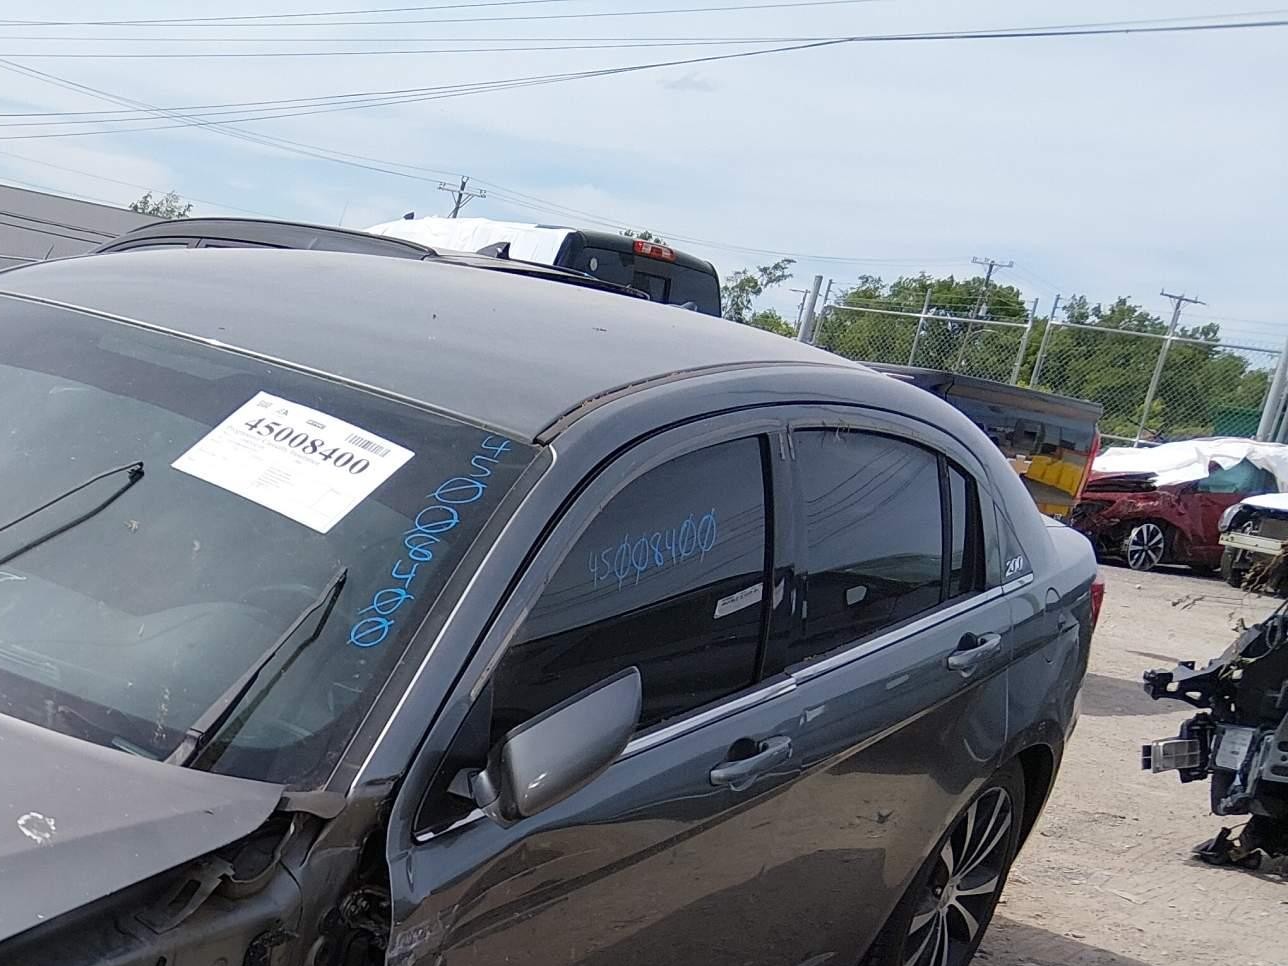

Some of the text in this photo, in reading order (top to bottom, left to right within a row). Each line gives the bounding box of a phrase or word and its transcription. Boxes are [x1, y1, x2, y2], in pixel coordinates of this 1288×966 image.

[244, 417, 370, 475] 45008400
[346, 436, 512, 647] 45008400
[588, 508, 717, 593] 45008400
[1005, 555, 1023, 578] 200
